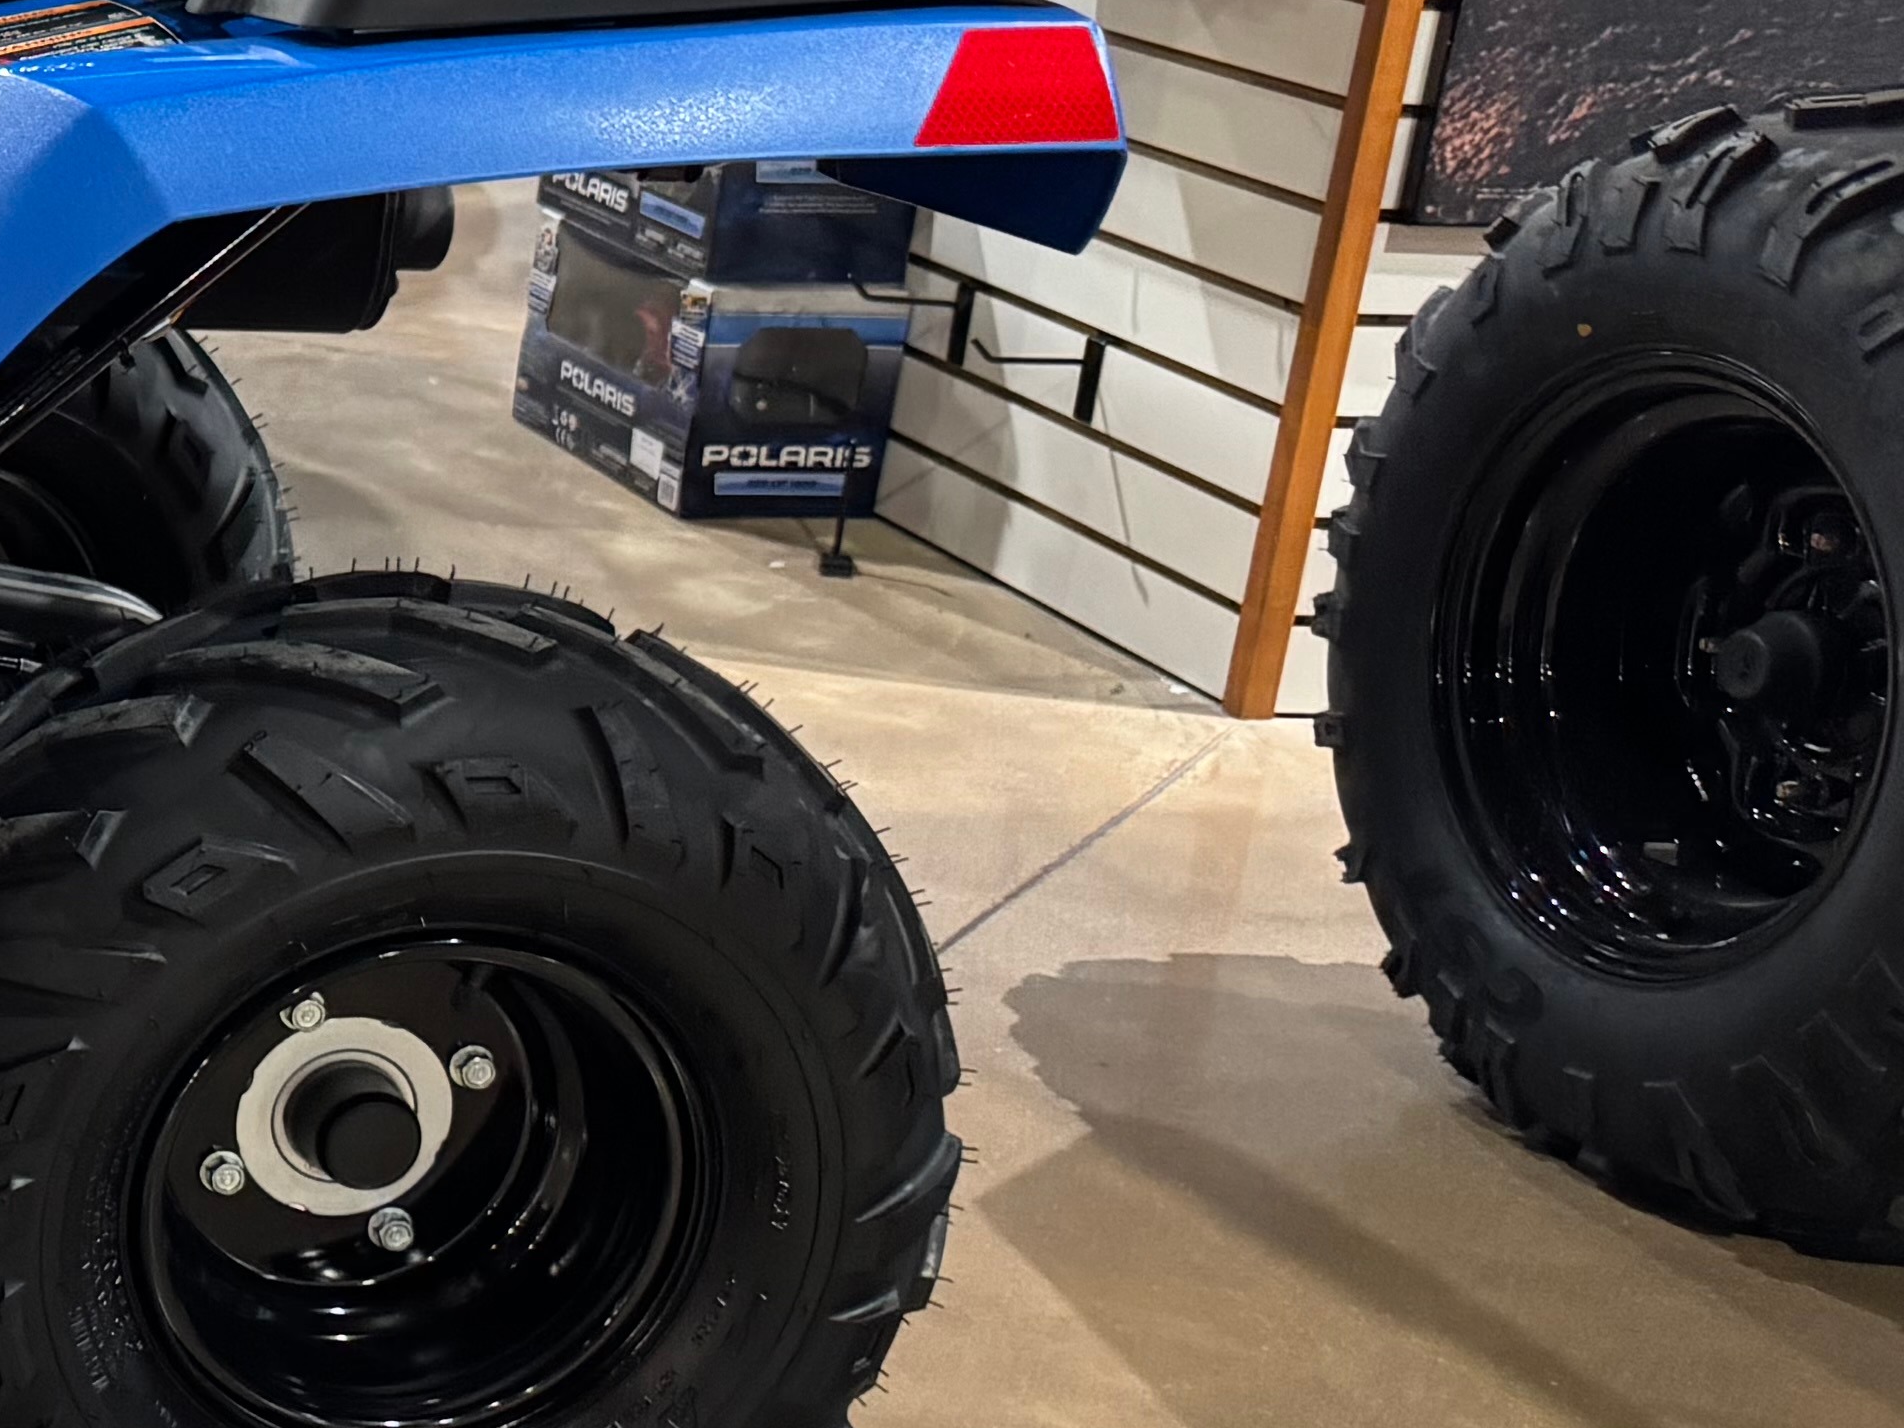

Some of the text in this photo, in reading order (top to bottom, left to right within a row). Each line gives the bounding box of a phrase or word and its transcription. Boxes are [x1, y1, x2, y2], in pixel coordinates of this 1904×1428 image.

[552, 173, 629, 214] POLARIS
[561, 360, 637, 417] POLARIS
[702, 445, 872, 469] POLARIS
